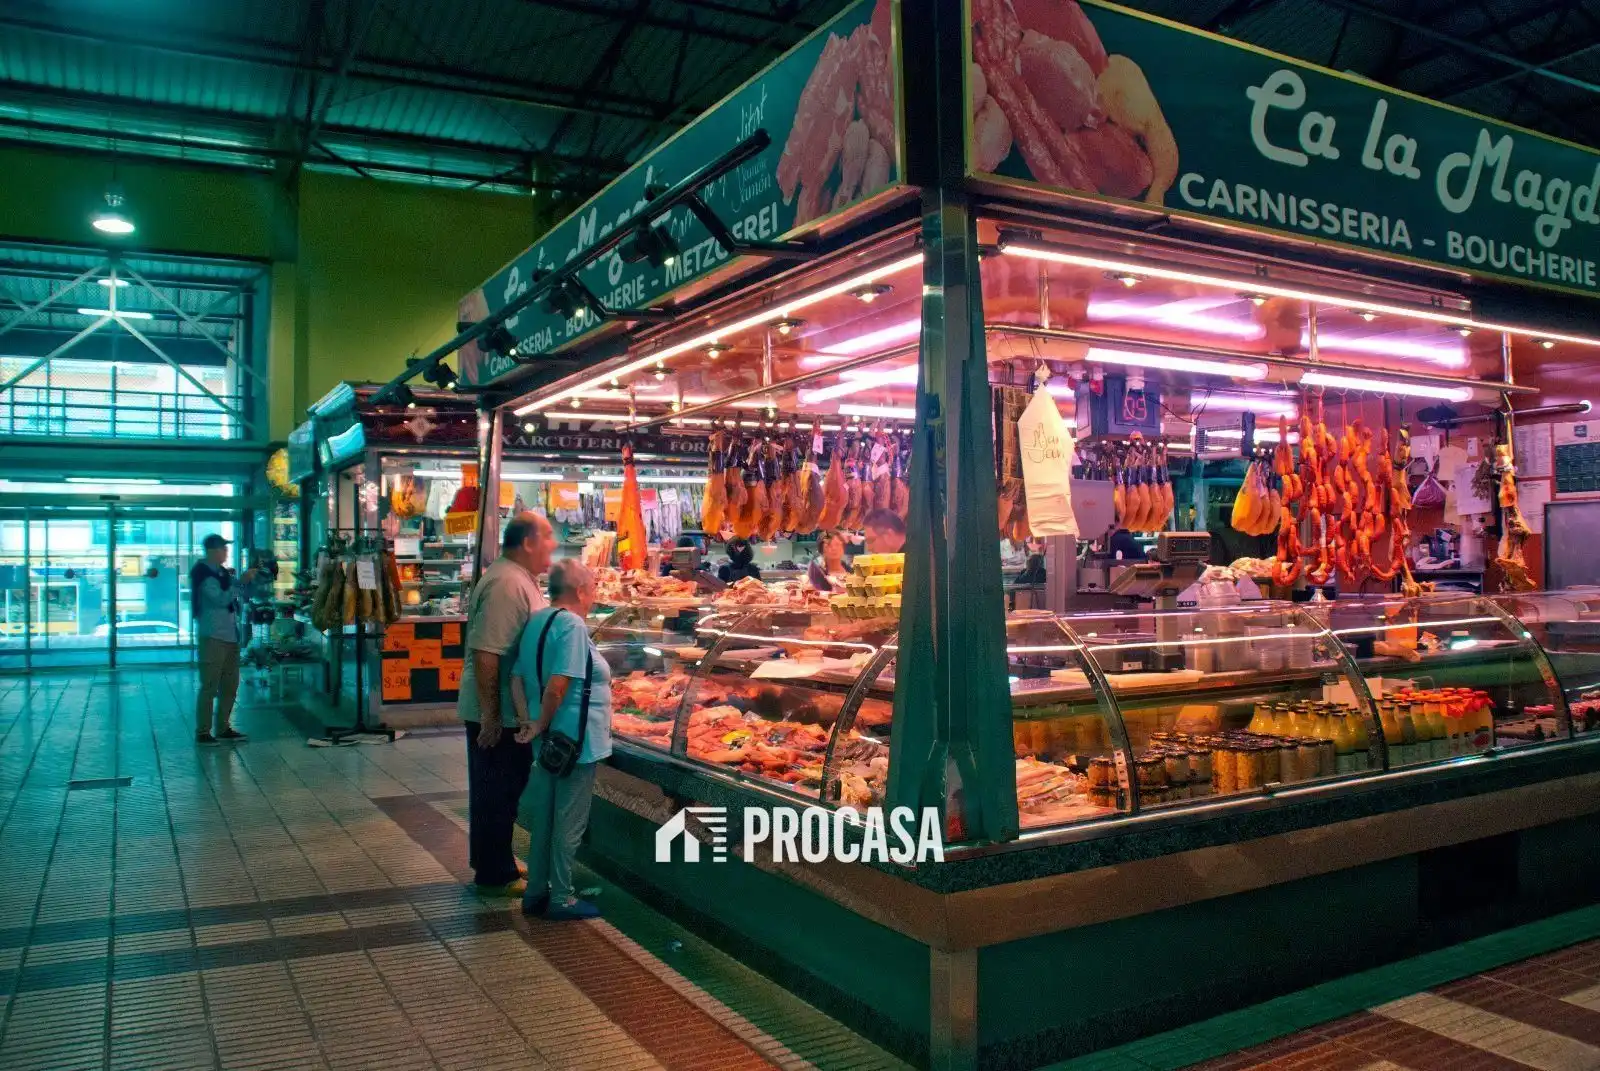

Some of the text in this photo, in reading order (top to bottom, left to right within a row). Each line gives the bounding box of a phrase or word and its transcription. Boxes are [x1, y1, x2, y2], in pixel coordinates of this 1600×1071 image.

[1246, 68, 1340, 167] Ca
[1361, 98, 1421, 179] la
[1178, 172, 1412, 251] CARNISSERIA
[1447, 230, 1597, 287] BOUCHERIE
